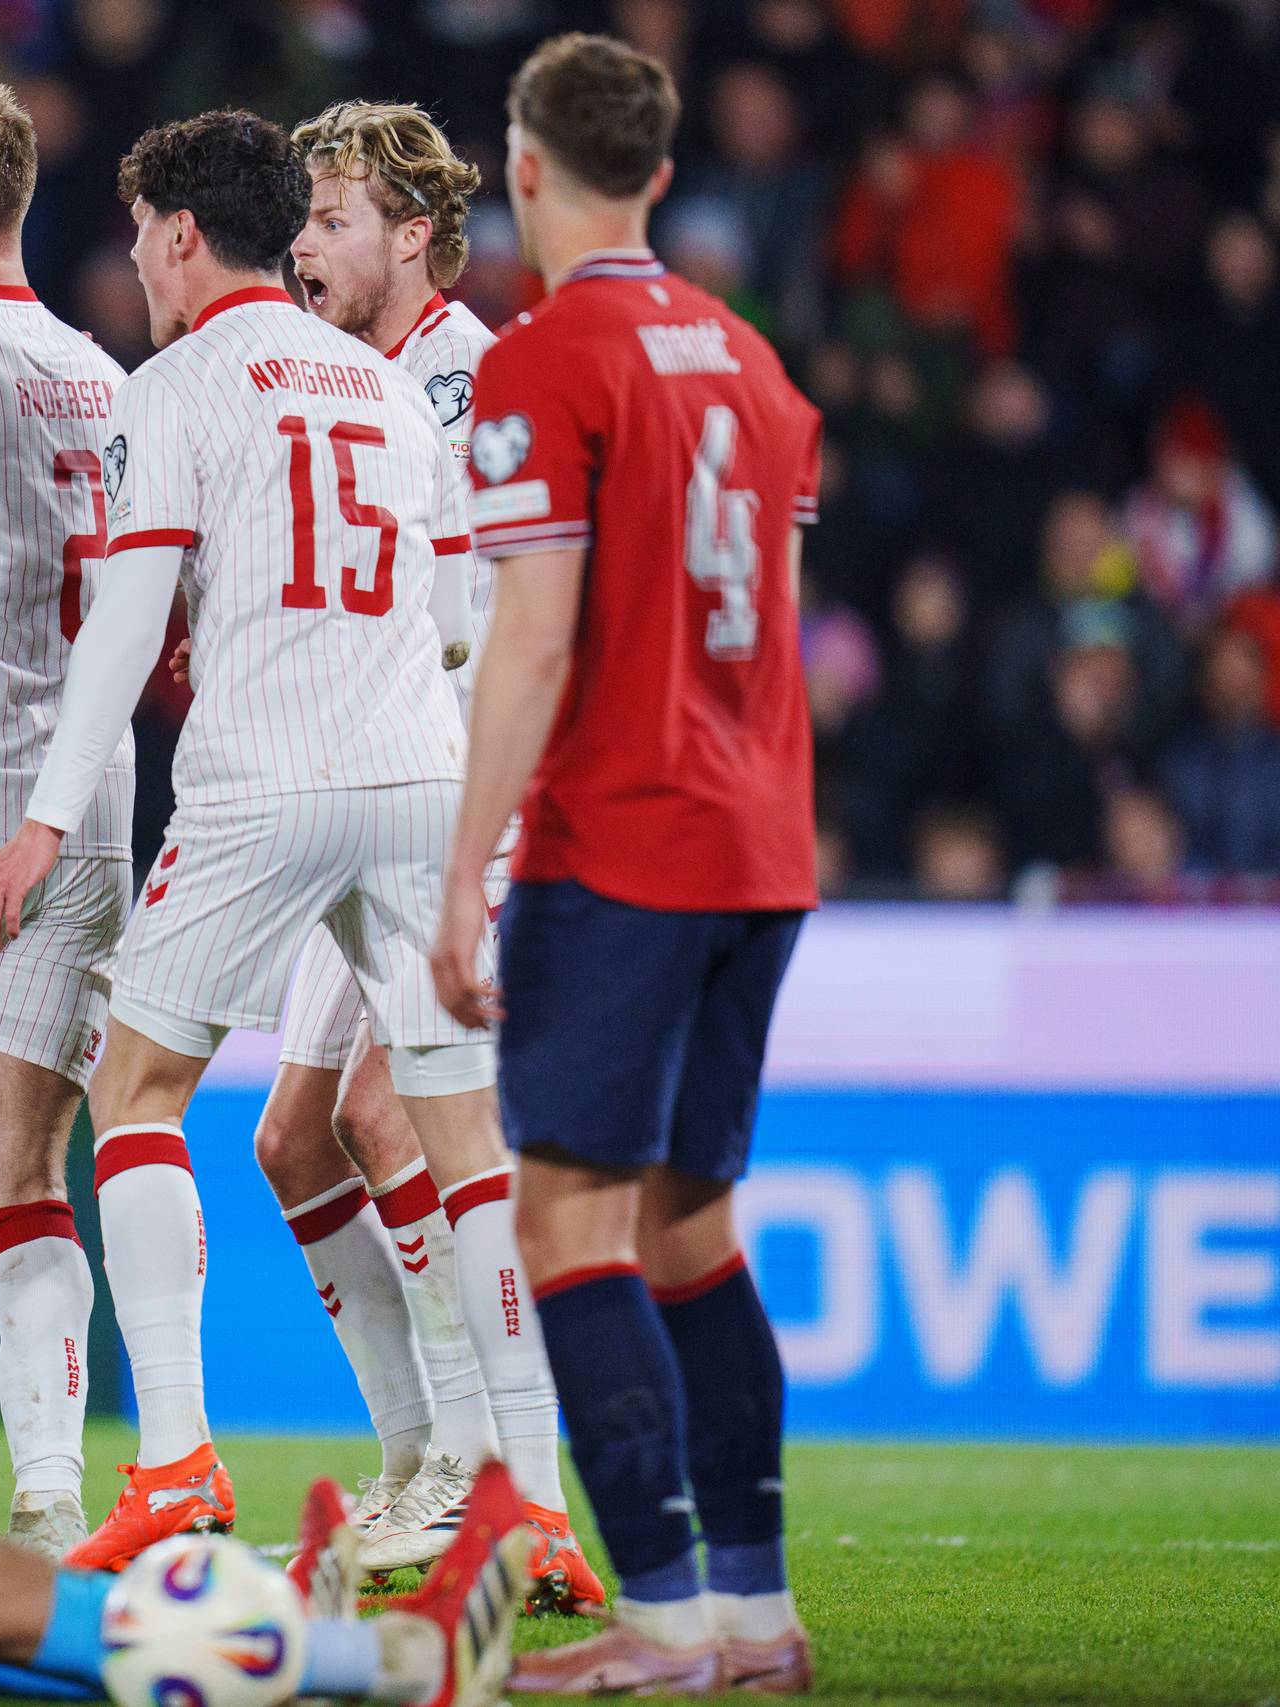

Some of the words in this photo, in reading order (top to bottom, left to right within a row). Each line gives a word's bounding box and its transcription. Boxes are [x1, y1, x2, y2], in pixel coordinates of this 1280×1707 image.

[248, 358, 384, 401] NØRGAARD
[277, 415, 398, 617] 15
[685, 405, 761, 661] 4
[499, 1268, 521, 1337] DANMARK
[64, 1338, 80, 1398] DANMARK
